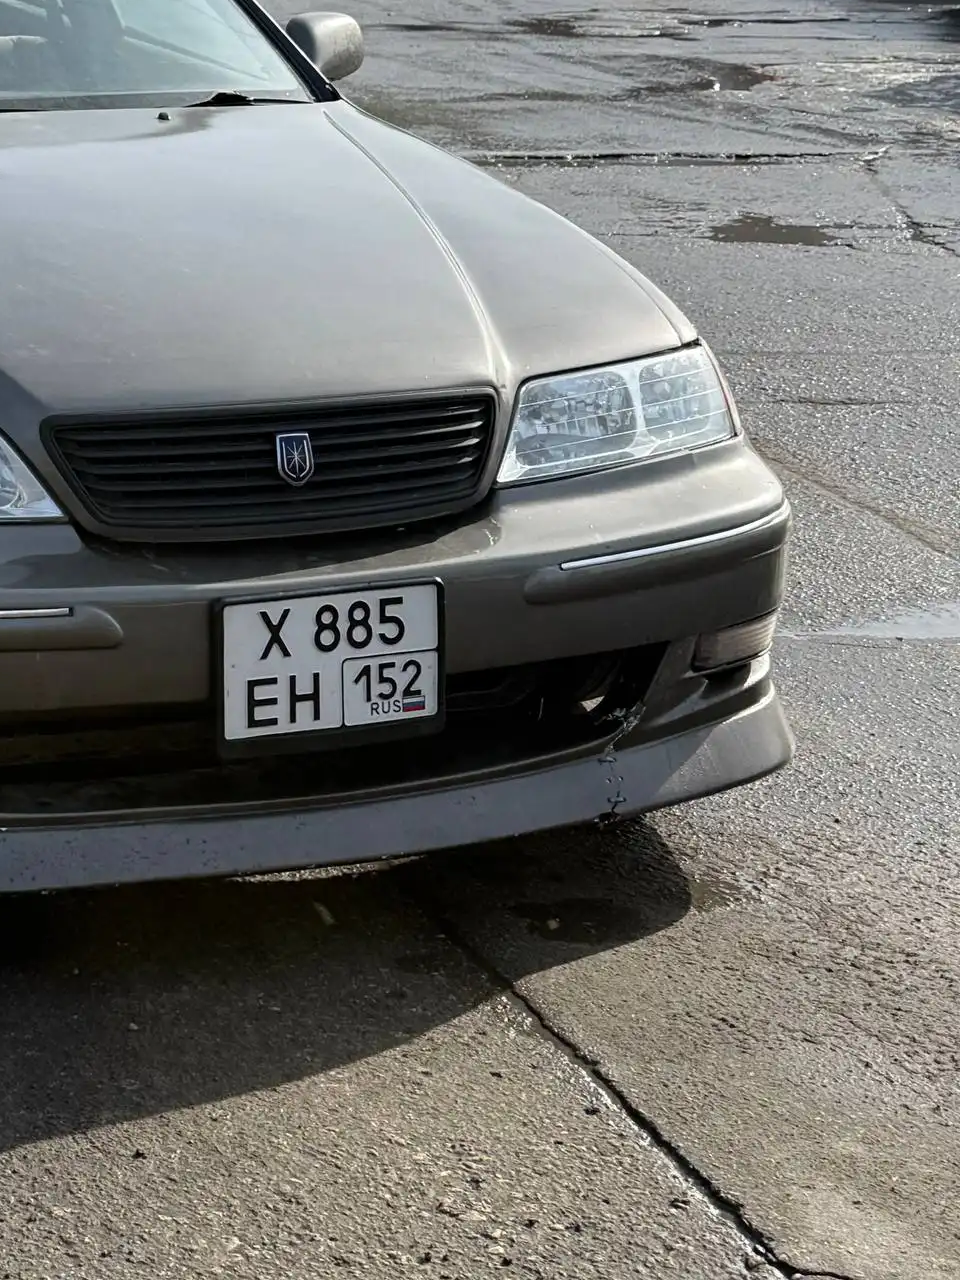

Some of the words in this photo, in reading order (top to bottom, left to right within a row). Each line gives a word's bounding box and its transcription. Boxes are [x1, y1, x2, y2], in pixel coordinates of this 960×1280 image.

[313, 596, 406, 653] 885
[352, 659, 423, 703] 152
[369, 699, 402, 717] RUS
